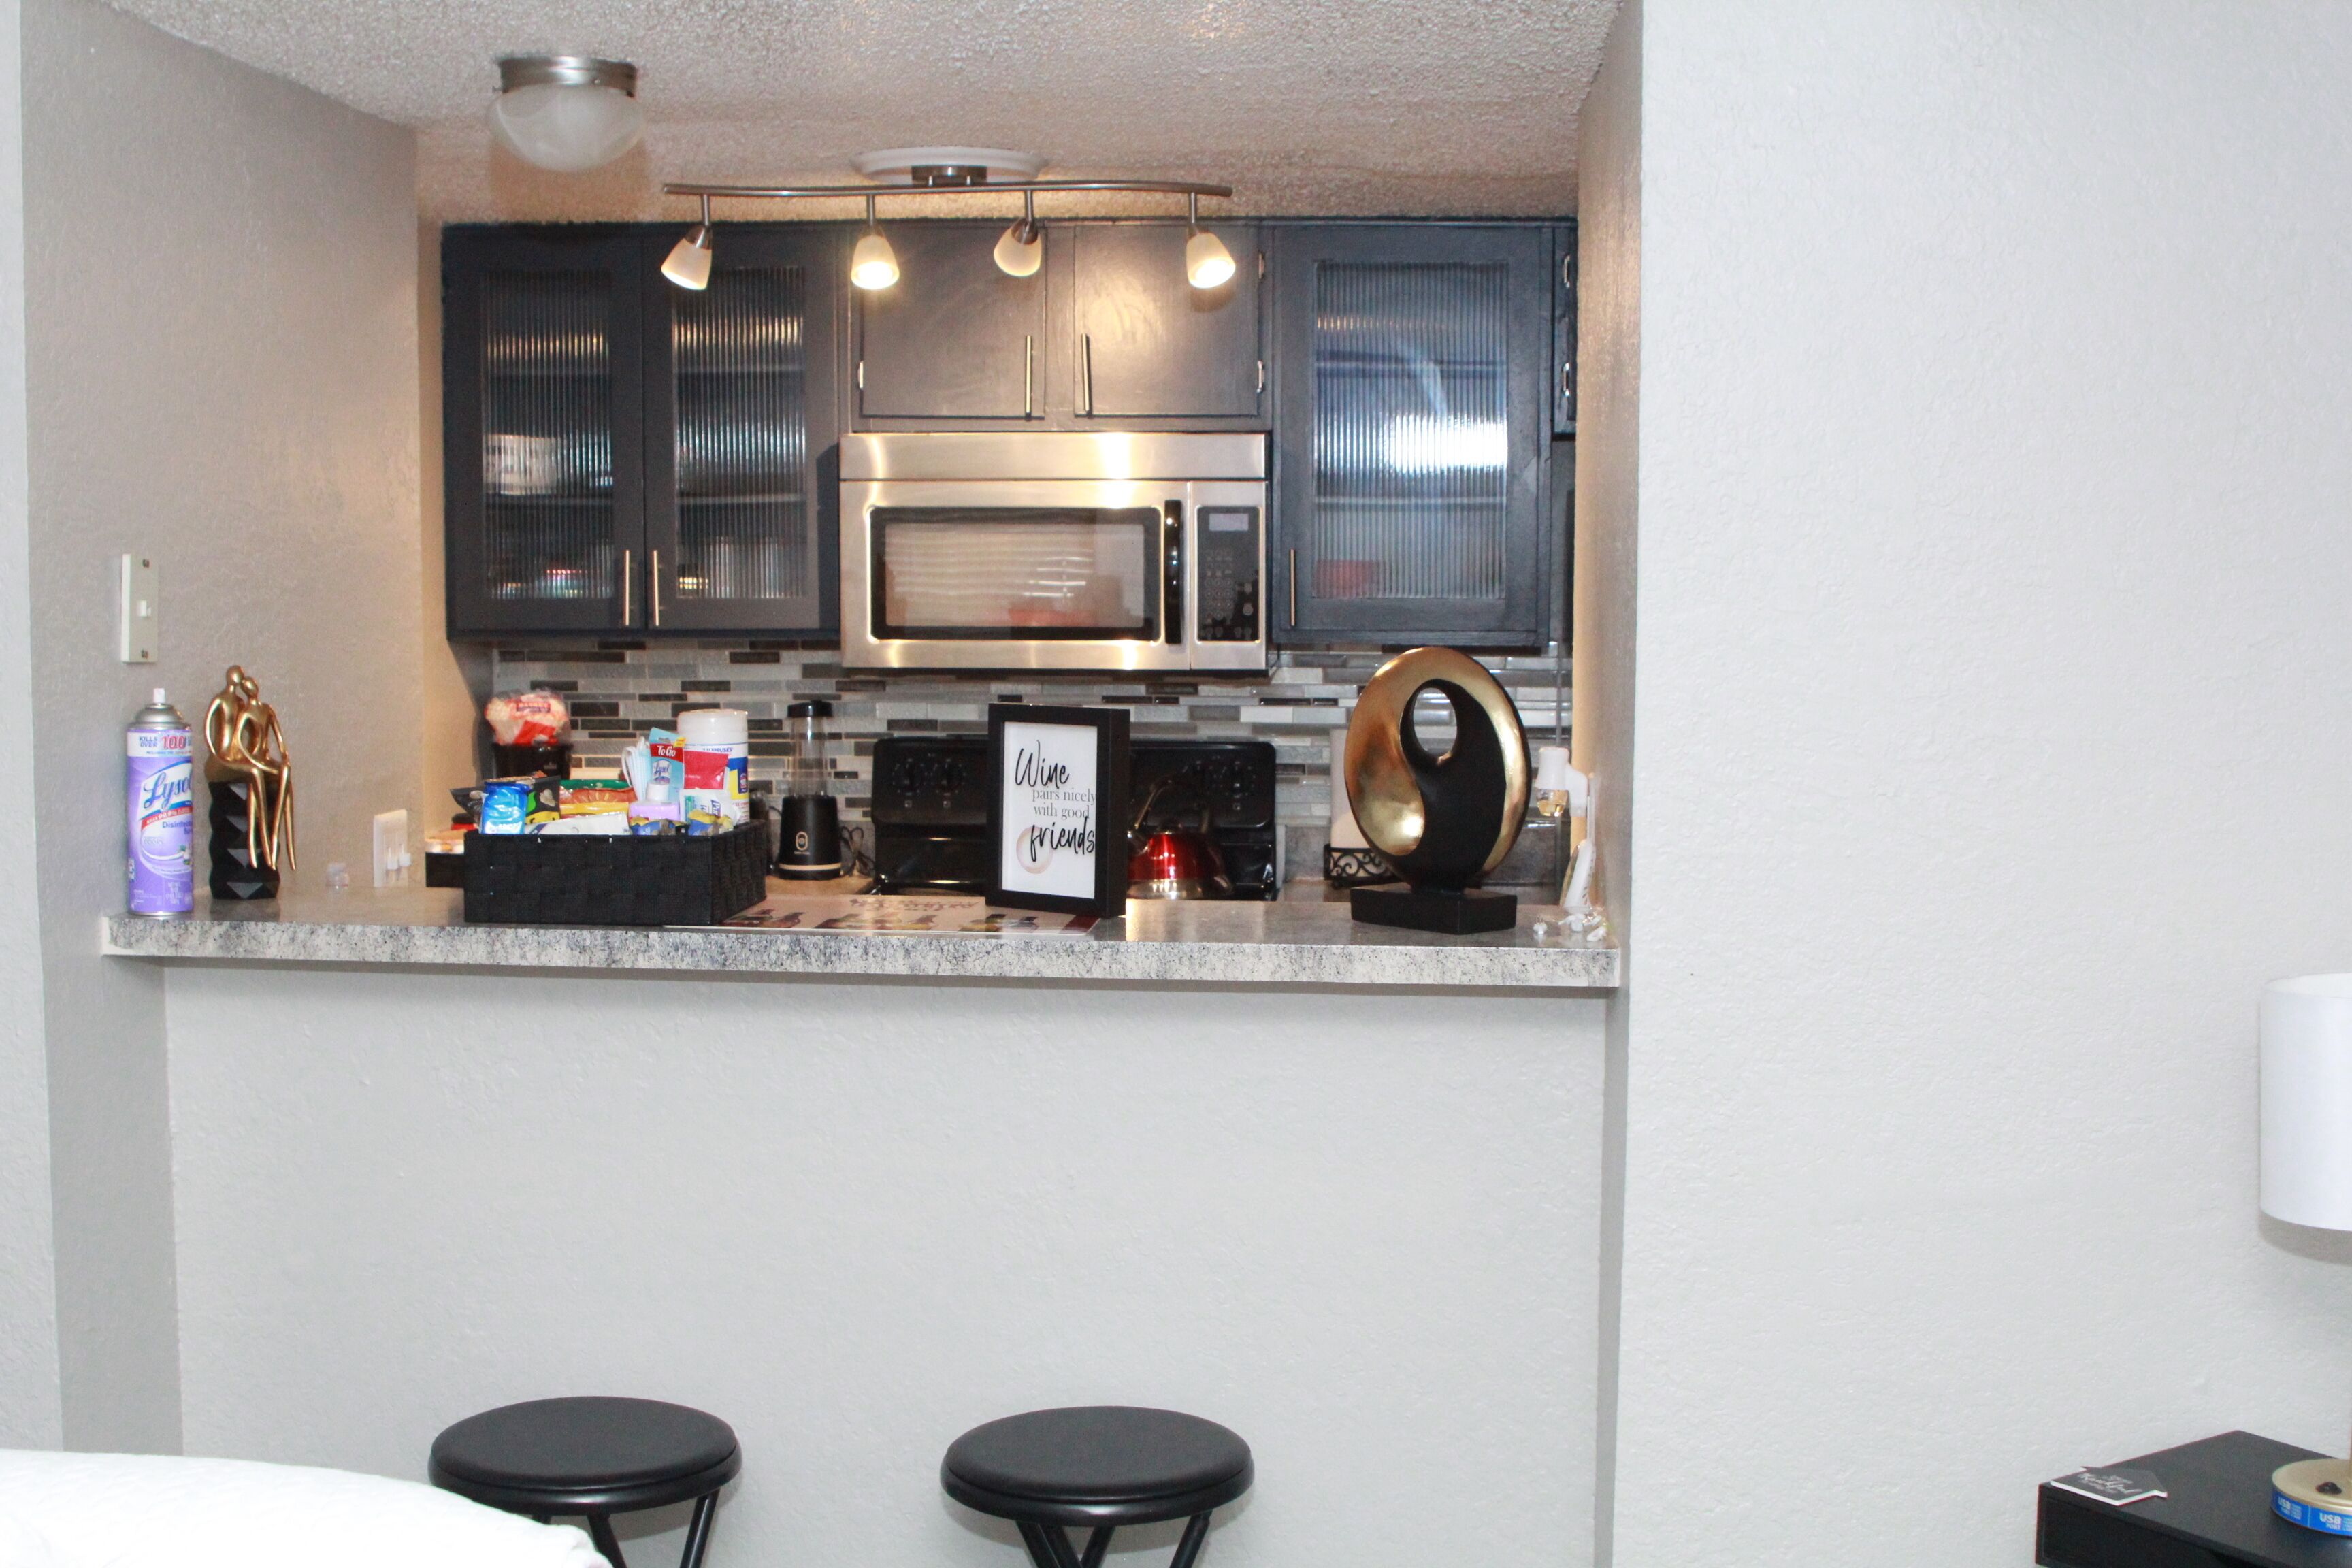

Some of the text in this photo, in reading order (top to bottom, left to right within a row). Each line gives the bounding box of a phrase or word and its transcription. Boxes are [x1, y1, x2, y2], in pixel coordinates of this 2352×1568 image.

[161, 735, 186, 749] 100
[657, 745, 676, 757] To Go
[1015, 739, 1070, 789] Wine
[1032, 785, 1096, 806] pairs nicely
[1034, 802, 1089, 820] with good
[1030, 815, 1095, 862] friends
[2319, 1512, 2342, 1525] USB
